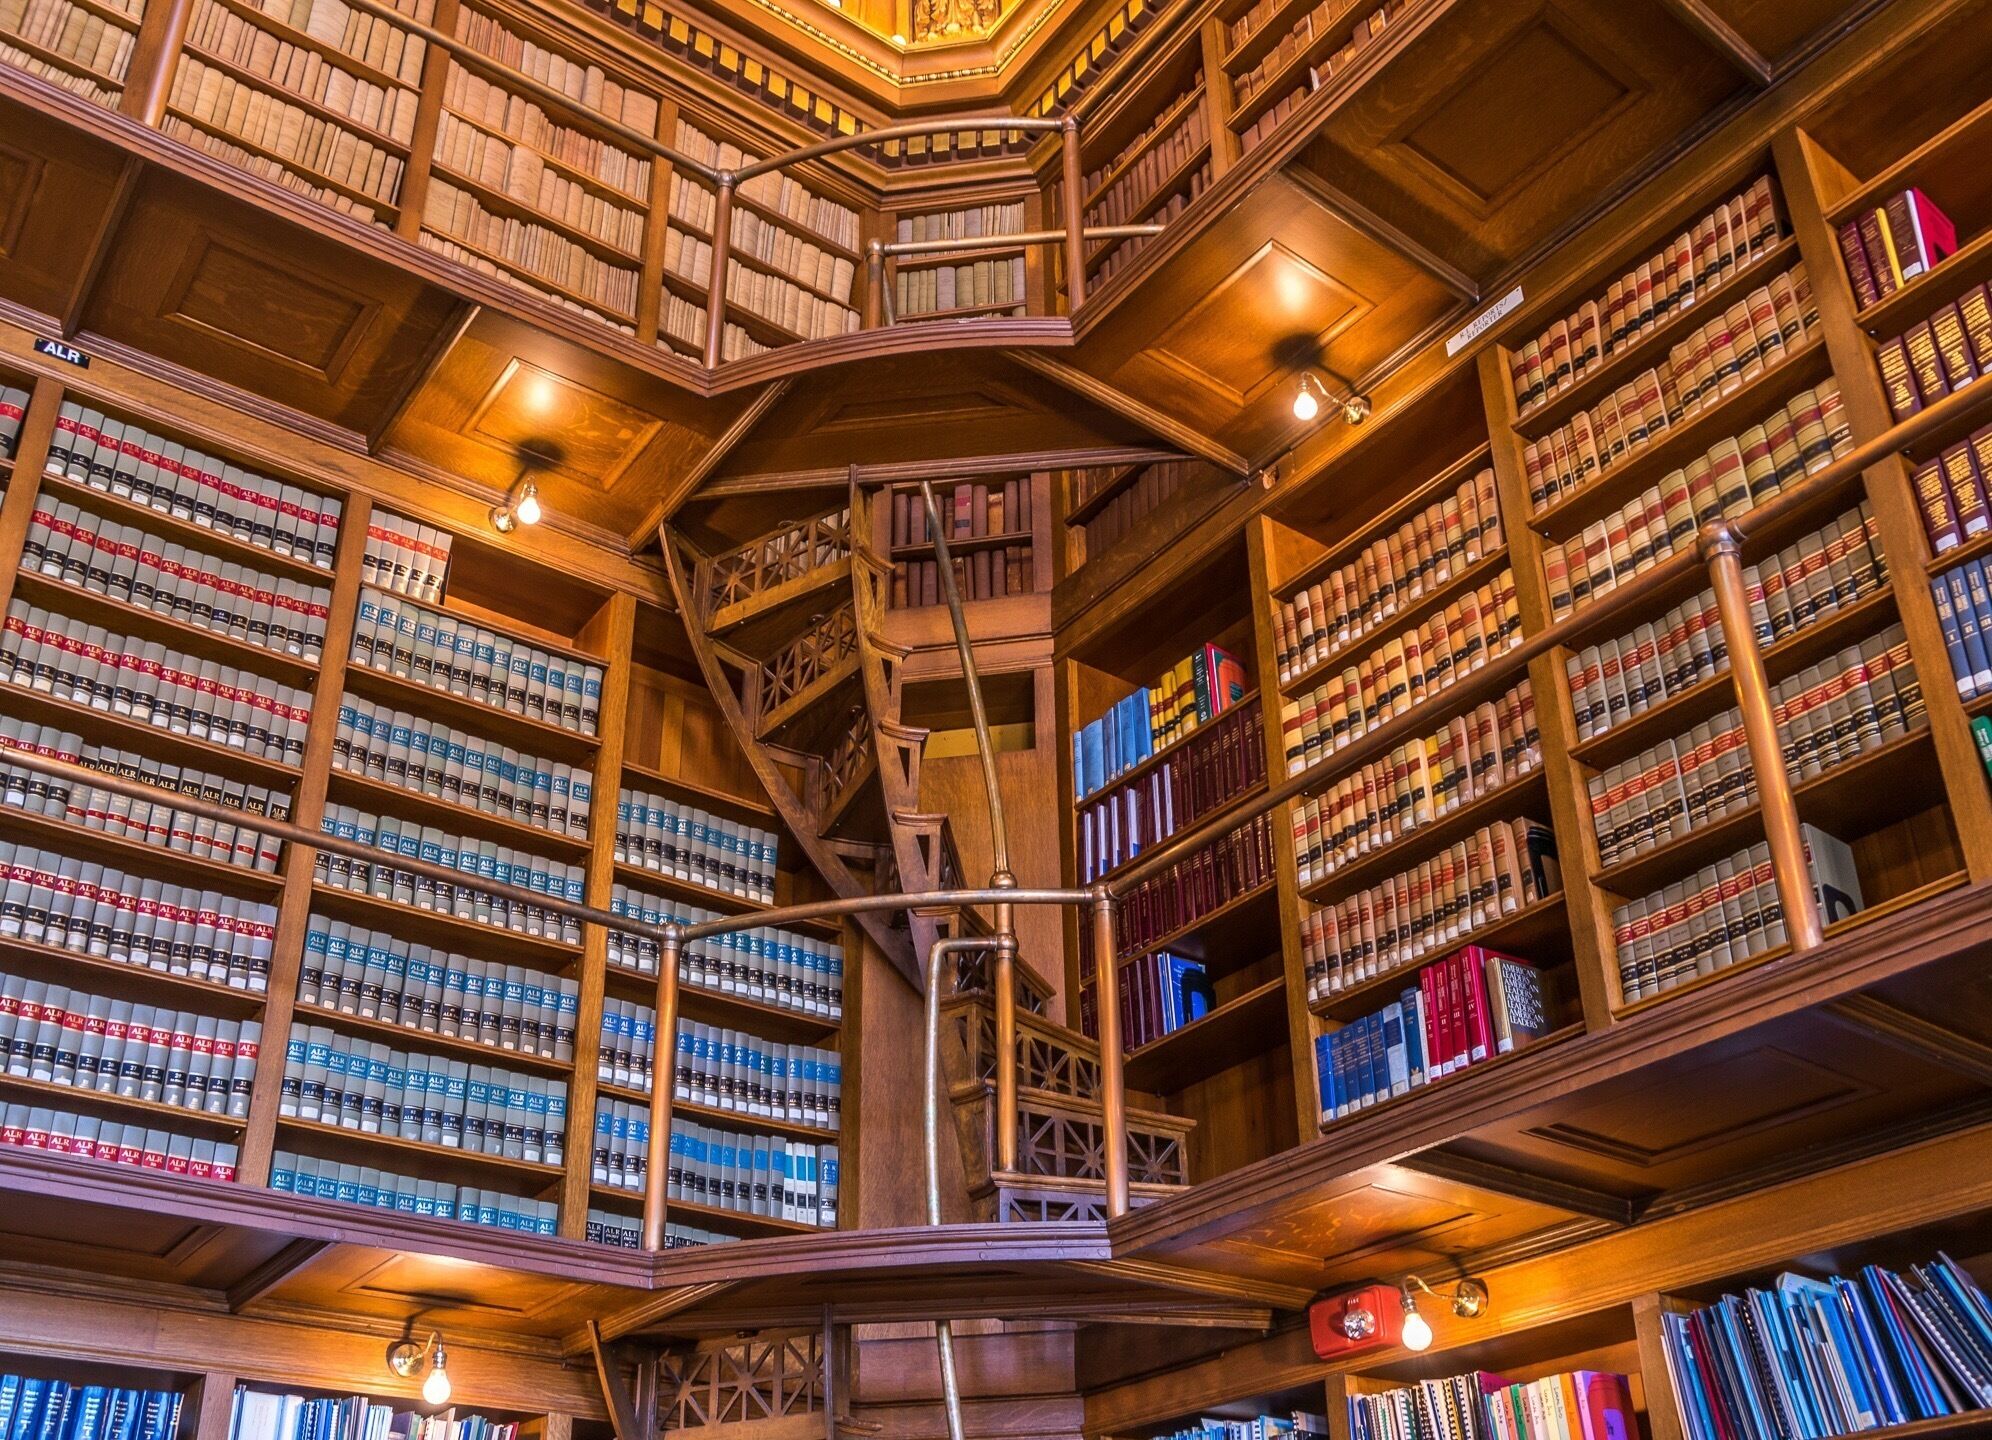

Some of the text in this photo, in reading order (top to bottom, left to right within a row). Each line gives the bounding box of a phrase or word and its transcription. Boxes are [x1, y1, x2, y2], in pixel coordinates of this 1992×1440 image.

[44, 341, 81, 363] ALR
[77, 531, 94, 540] ALR
[121, 546, 138, 555] ALR
[143, 553, 161, 563] ALR
[163, 562, 180, 570] ALR
[182, 569, 199, 578] ALR
[202, 575, 218, 583] ALR
[240, 586, 255, 594] ALR
[258, 593, 274, 601] ALR
[277, 596, 293, 605] ALR
[294, 602, 309, 610] ALR
[5, 618, 23, 628] ALR
[25, 627, 43, 637] ALR
[46, 634, 64, 644] ALR
[65, 641, 82, 650] ALR
[84, 647, 102, 656] ALR
[143, 663, 160, 672] ALR
[162, 670, 178, 679] ALR
[181, 675, 197, 684] ALR
[201, 681, 216, 690] ALR
[219, 686, 235, 695] ALR
[238, 691, 253, 700] ALR
[256, 697, 272, 706] ALR
[292, 710, 308, 718] ALR
[17, 742, 36, 751] ALR
[58, 754, 76, 763] ALR
[98, 765, 116, 774] ALR
[118, 768, 136, 778] ALR
[139, 777, 156, 785] ALR
[158, 781, 176, 790] ALR
[182, 786, 199, 795] ALR
[203, 791, 220, 800] ALR
[224, 797, 240, 806] ALR
[247, 802, 263, 811] ALR
[272, 808, 286, 817] ALR
[13, 869, 31, 878] ALR
[36, 874, 54, 884] ALR
[58, 880, 75, 889] ALR
[79, 884, 96, 893] ALR
[100, 891, 117, 901] ALR
[120, 898, 136, 907] ALR
[140, 902, 157, 911] ALR
[160, 906, 177, 916] ALR
[200, 913, 216, 922] ALR
[218, 918, 235, 926] ALR
[238, 922, 254, 930] ALR
[257, 926, 273, 935] ALR
[1502, 963, 1536, 978] AMERICAN
[1503, 970, 1530, 985] LEADERS
[1505, 978, 1539, 992] AMERICAN
[1505, 985, 1532, 998] LEADERS
[1, 1001, 18, 1009] ALR
[1507, 993, 1541, 1008] AMERICAN
[23, 1005, 40, 1014] ALR
[1507, 1000, 1535, 1013] LEADERS
[45, 1010, 62, 1019] ALR
[1509, 1008, 1544, 1023] AMERICAN
[67, 1017, 84, 1025] ALR
[88, 1020, 105, 1029] ALR
[1510, 1015, 1537, 1028] LEADERS
[110, 1025, 126, 1034] ALR
[132, 1029, 149, 1038] ALR
[153, 1032, 170, 1041] ALR
[176, 1036, 192, 1045] ALR
[197, 1041, 213, 1049] ALR
[217, 1043, 233, 1051] ALR
[240, 1045, 257, 1053] ALR
[4, 1130, 22, 1140] ALR
[28, 1132, 46, 1143] ALR
[52, 1137, 69, 1147] ALR
[76, 1141, 93, 1151] ALR
[99, 1146, 116, 1155] ALR
[122, 1150, 138, 1159] ALR
[147, 1154, 162, 1164] ALR
[170, 1159, 186, 1168] ALR
[192, 1163, 208, 1172] ALR
[216, 1167, 231, 1176] ALR
